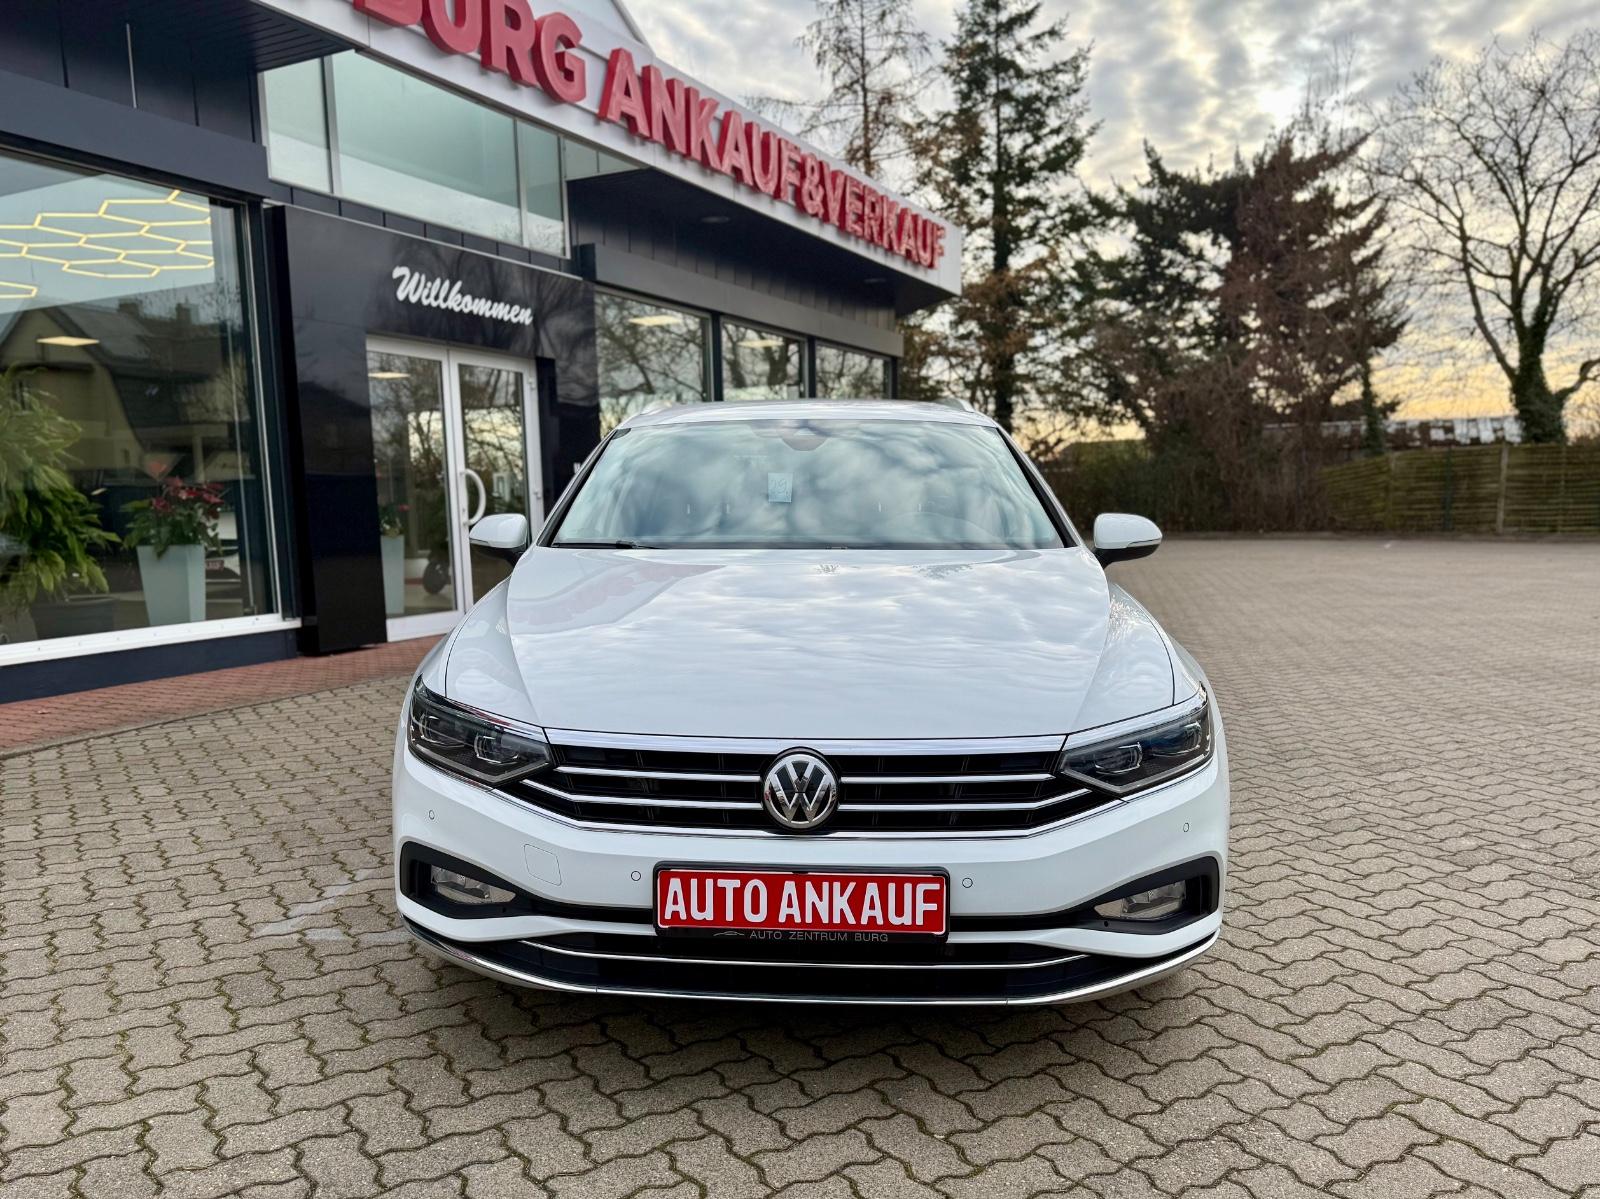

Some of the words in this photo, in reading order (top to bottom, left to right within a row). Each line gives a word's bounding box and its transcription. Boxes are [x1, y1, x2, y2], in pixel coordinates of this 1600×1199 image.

[354, 0, 586, 103] URG
[598, 47, 945, 270] ANKAUF&VERKAUF
[392, 265, 533, 325] Willkommen
[664, 878, 768, 923] AUTO
[778, 880, 941, 926] ANKAUF
[749, 930, 782, 940] AUTO
[788, 931, 848, 941] ZENTRUM
[854, 932, 889, 942] BURG
